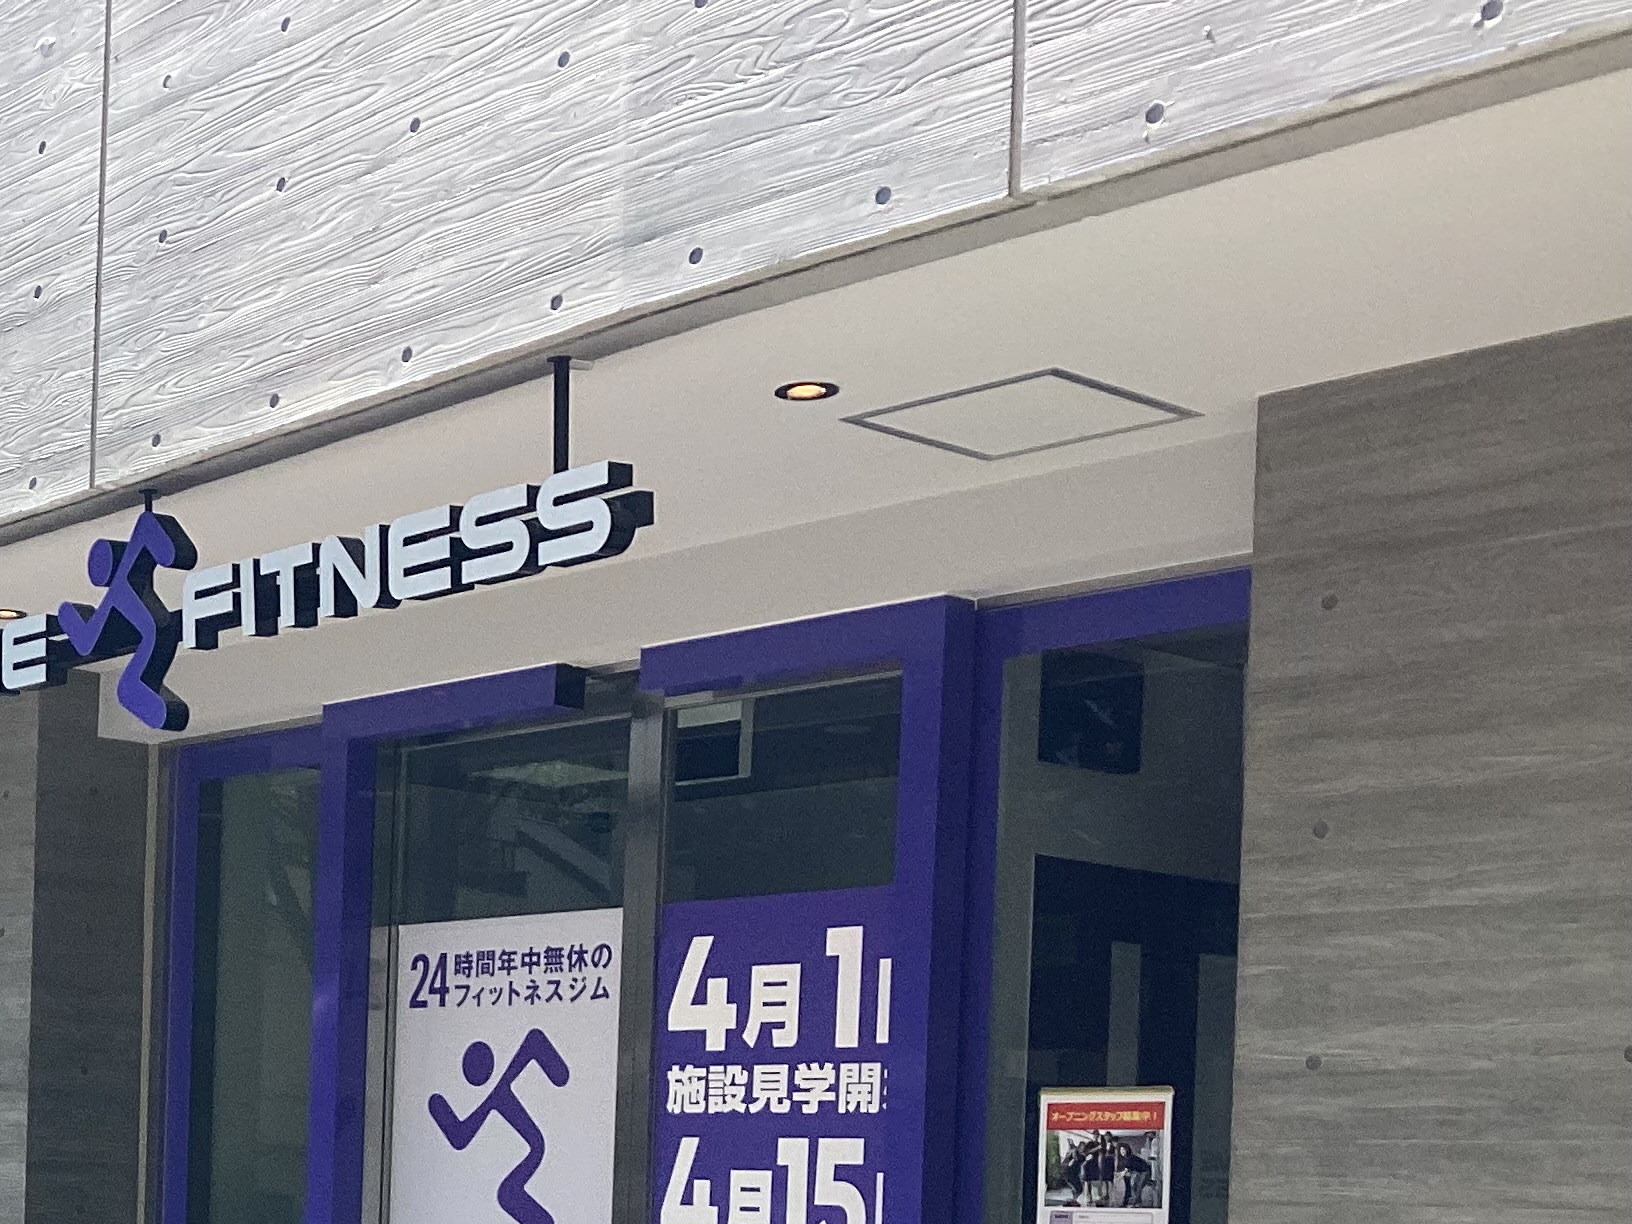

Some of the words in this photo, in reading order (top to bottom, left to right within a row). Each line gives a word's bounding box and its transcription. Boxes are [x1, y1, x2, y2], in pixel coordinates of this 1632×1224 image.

[181, 460, 612, 649] FITNESS
[409, 953, 449, 1009] 24
[453, 942, 613, 977] 時間年中無休の
[454, 976, 611, 1007] フィットネスジム
[667, 925, 892, 1052] 4月1
[666, 1062, 888, 1115] 施設見学開
